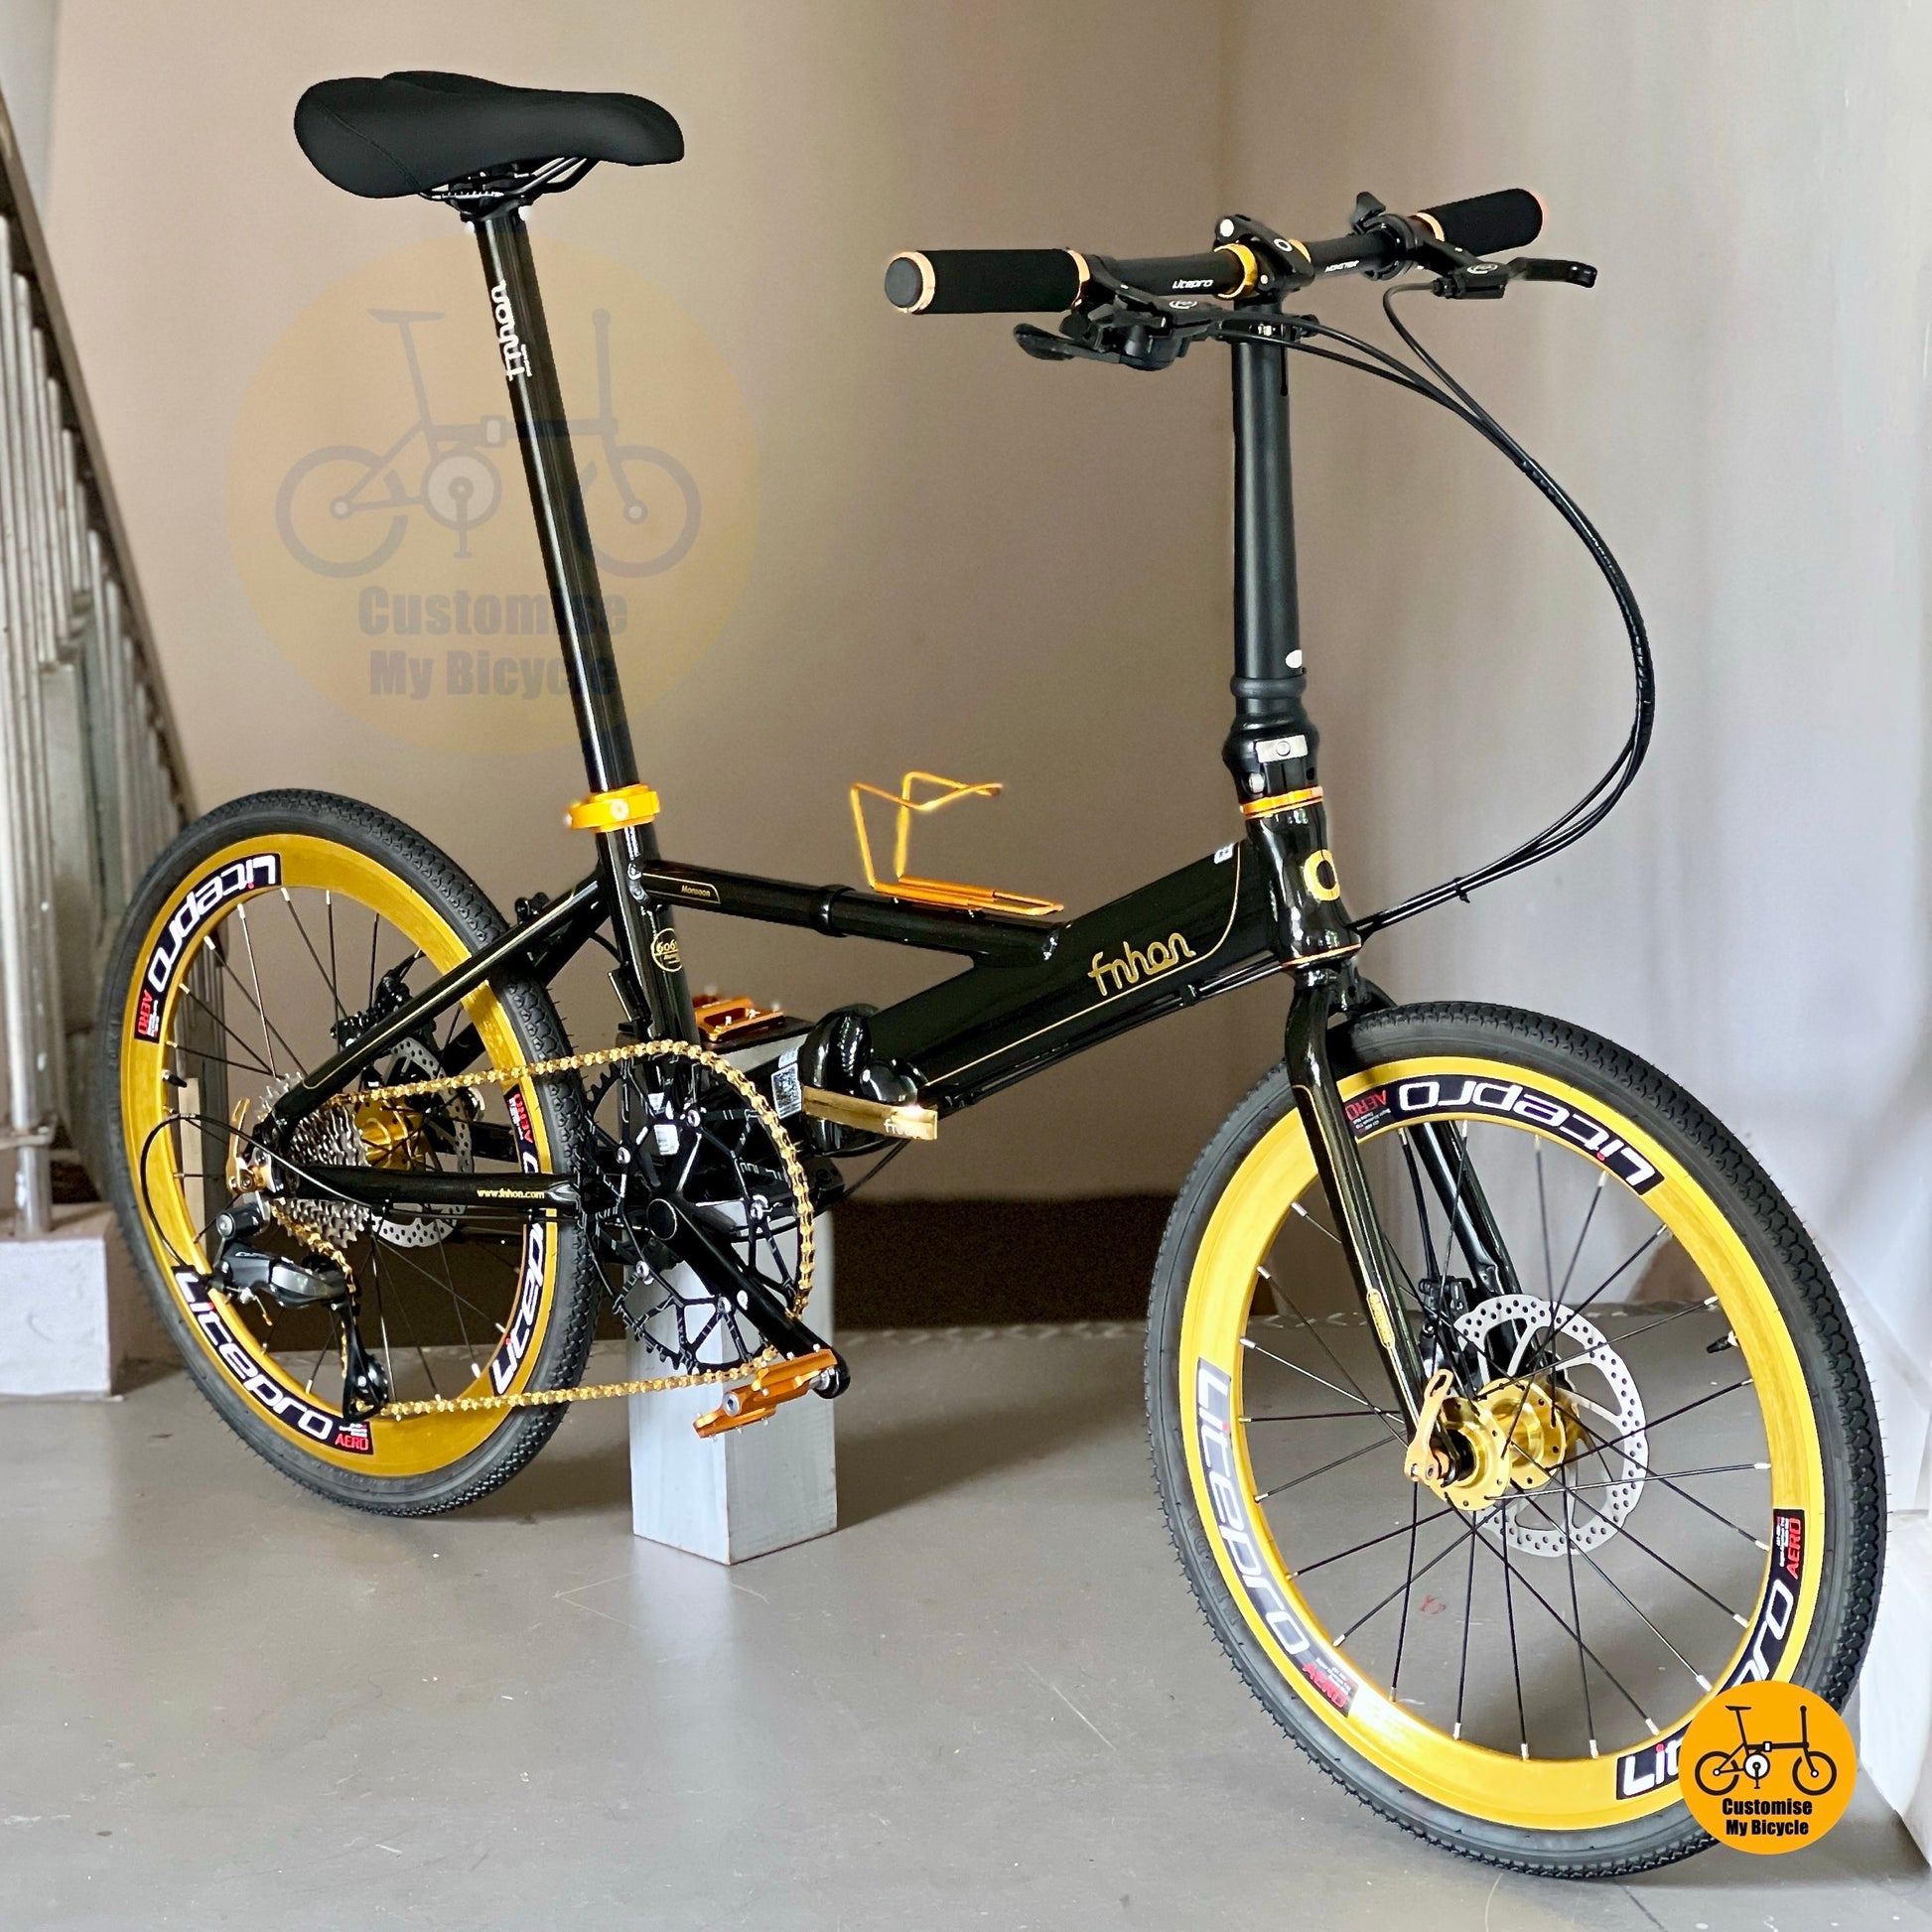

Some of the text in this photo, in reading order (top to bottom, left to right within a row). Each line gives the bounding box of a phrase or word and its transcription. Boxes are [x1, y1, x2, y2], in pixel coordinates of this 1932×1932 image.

[148, 855, 276, 993] Litepro
[138, 989, 153, 1035] AERO
[1344, 1090, 1387, 1120] AERO
[1399, 1080, 1655, 1186] Litepro
[477, 1188, 545, 1199] www.fnhon.com
[175, 1272, 334, 1440] Litepro
[335, 1433, 369, 1450] AERO
[1197, 1368, 1311, 1655] Litepro
[1787, 1517, 1802, 1580] AERO
